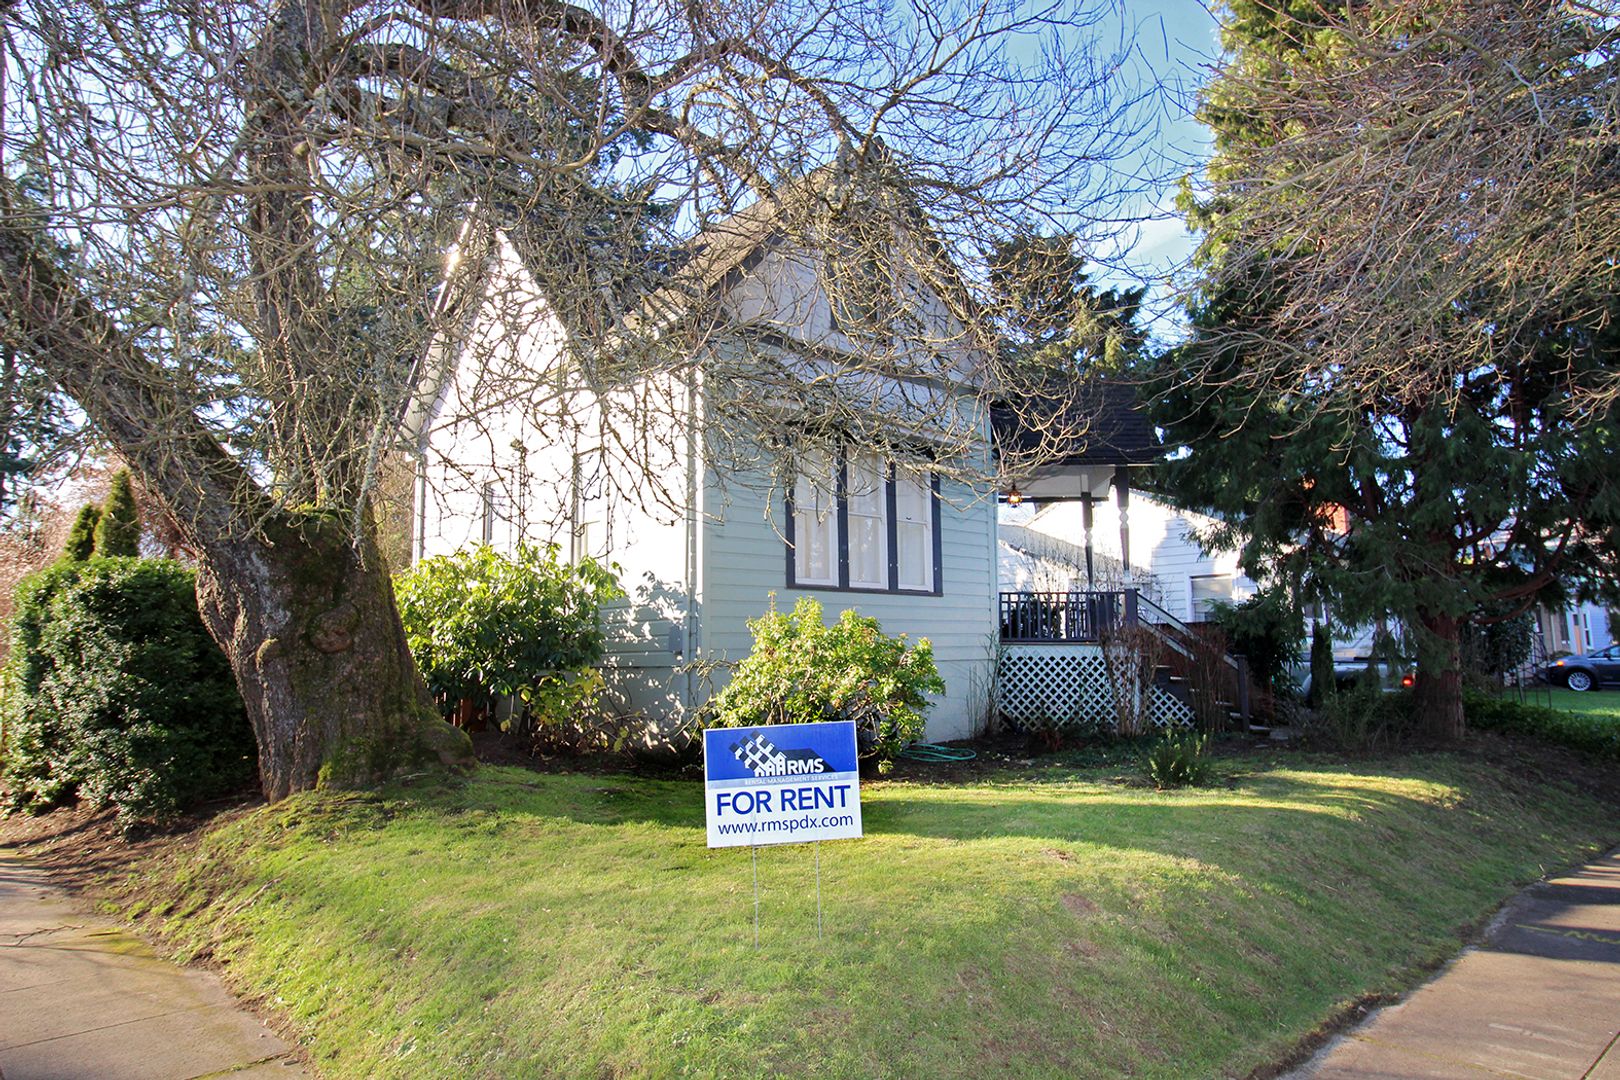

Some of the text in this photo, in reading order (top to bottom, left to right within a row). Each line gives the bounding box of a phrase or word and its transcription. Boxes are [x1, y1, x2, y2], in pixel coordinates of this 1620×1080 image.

[787, 758, 825, 774] RMS
[767, 775, 810, 784] MANAGEMENT
[812, 774, 839, 782] SERVICES
[717, 785, 851, 816] FOR RENT
[718, 814, 853, 834] www.rmspdx.com
